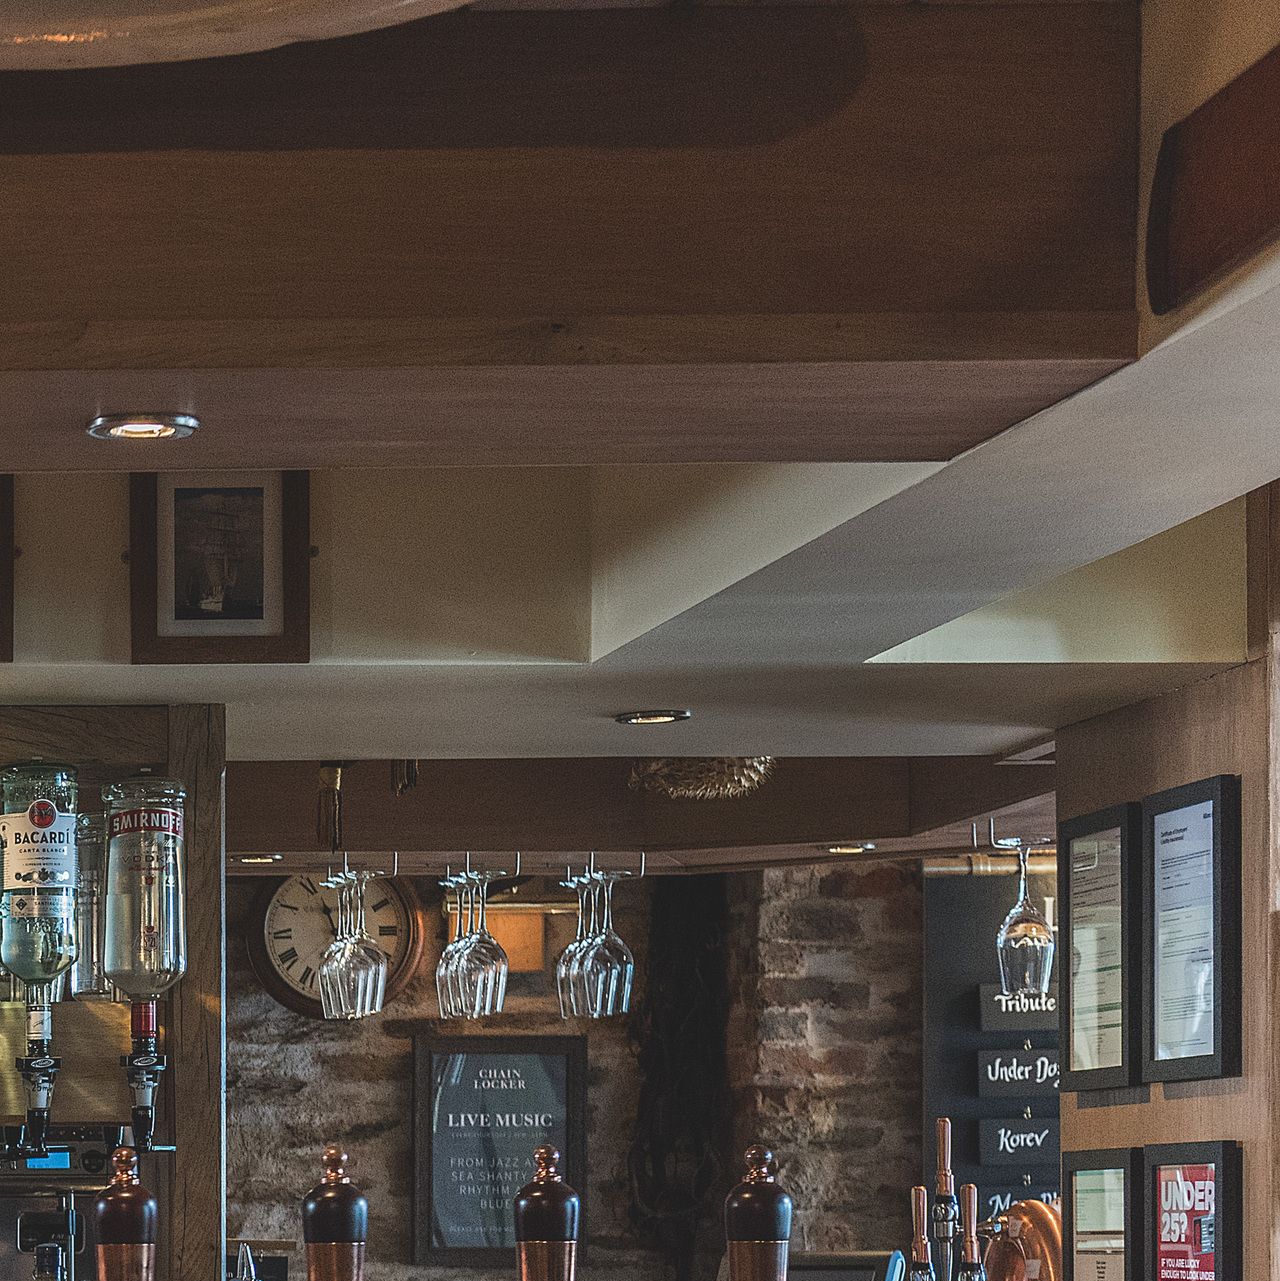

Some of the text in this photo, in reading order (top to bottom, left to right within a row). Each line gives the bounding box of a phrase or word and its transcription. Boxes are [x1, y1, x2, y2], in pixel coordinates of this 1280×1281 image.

[113, 814, 181, 833] SMIRNOFF
[995, 992, 1056, 1013] Tribute
[479, 1069, 521, 1079] CHAIN
[988, 1059, 1032, 1082] Under
[474, 1080, 527, 1090] LOCKER
[448, 1113, 553, 1127] LIVE MUSIC
[998, 1129, 1049, 1153] Korev
[450, 1157, 520, 1168] FROM JAZZ
[452, 1172, 528, 1182] SEA SHANTY
[460, 1185, 510, 1195] RHYTHM
[1161, 1181, 1215, 1214] UNDER
[1161, 1212, 1188, 1243] 25?
[1166, 1258, 1176, 1268] YOU
[1176, 1259, 1185, 1268] ARE
[1161, 1270, 1215, 1281] ENOUGH TO LOOK UNDER
